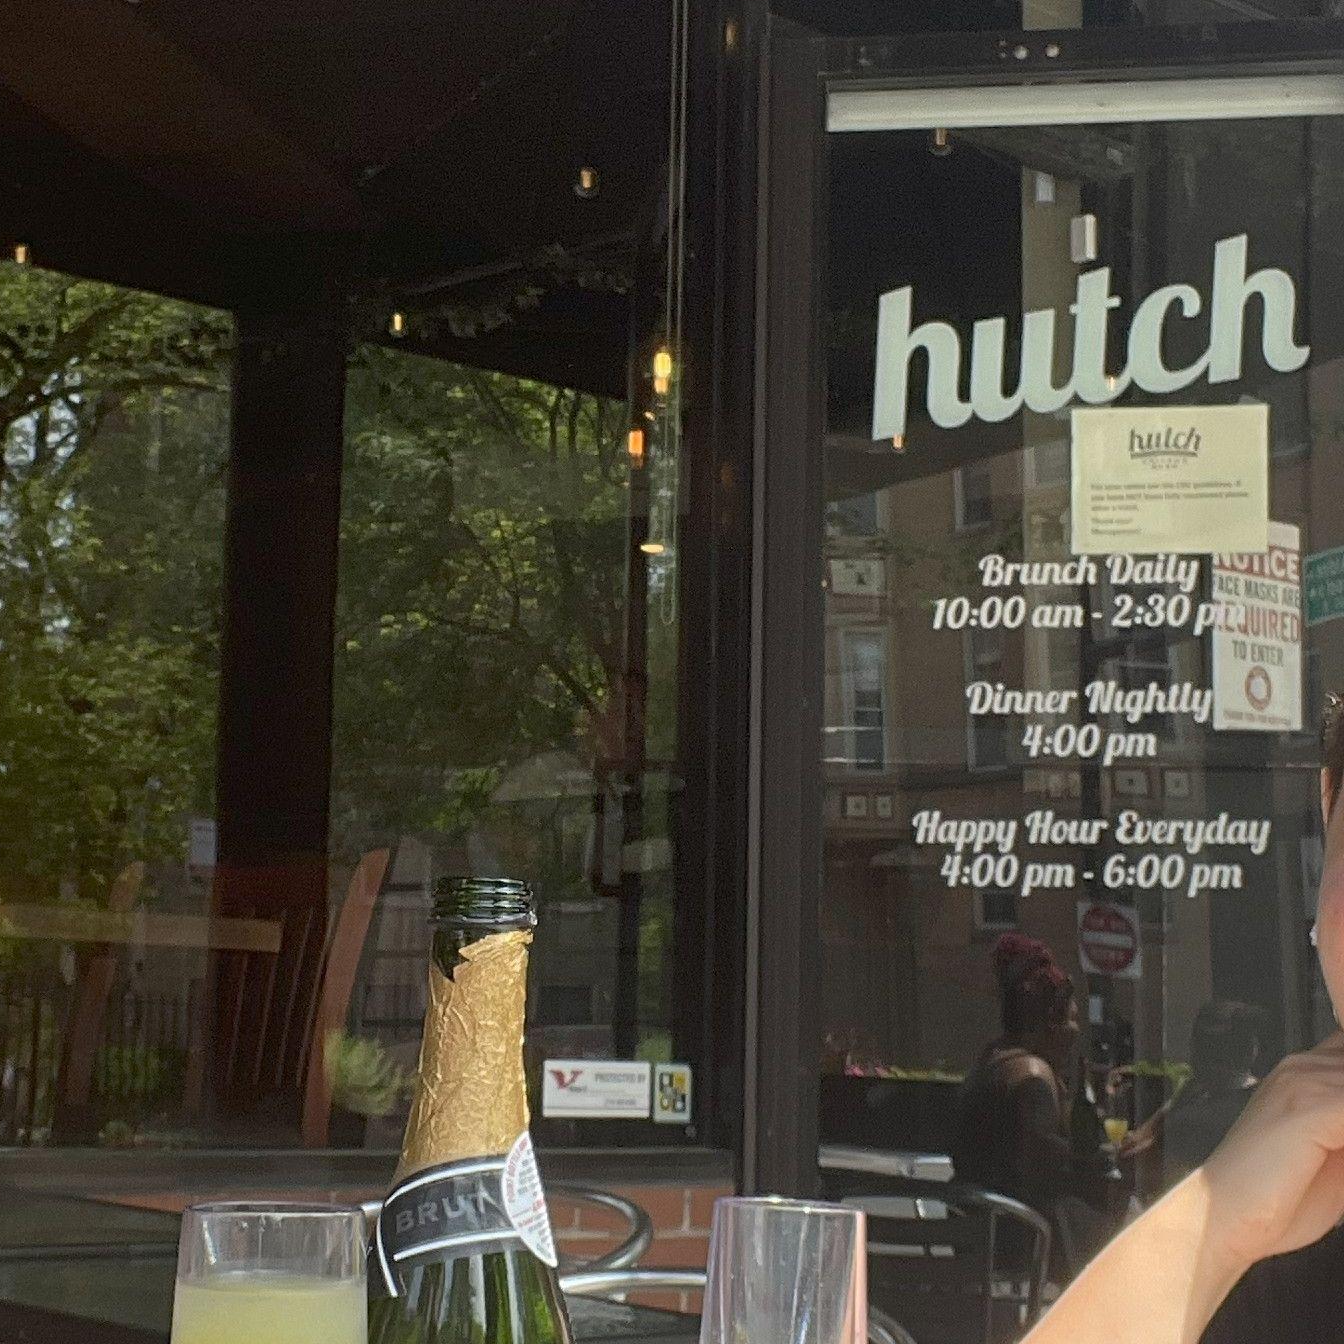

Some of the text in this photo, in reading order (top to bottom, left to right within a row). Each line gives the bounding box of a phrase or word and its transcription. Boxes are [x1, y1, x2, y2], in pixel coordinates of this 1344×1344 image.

[872, 233, 1310, 441] hutch
[978, 553, 1200, 592] Brunch Daily
[1244, 580, 1279, 603] MASKS
[932, 595, 1026, 630] 10:00
[1031, 604, 1085, 628] am
[1112, 594, 1190, 628] 2:30
[1250, 642, 1284, 667] ENTER
[966, 681, 1077, 715] Dinner
[1085, 681, 1213, 723] Nightly
[1022, 723, 1157, 766] 4:00 pm
[912, 809, 1271, 855] Happy Hour Everyday
[940, 854, 1019, 889] 4:00
[1021, 862, 1075, 897] pm
[1103, 854, 1185, 889] 6:00
[1187, 862, 1243, 898] pm
